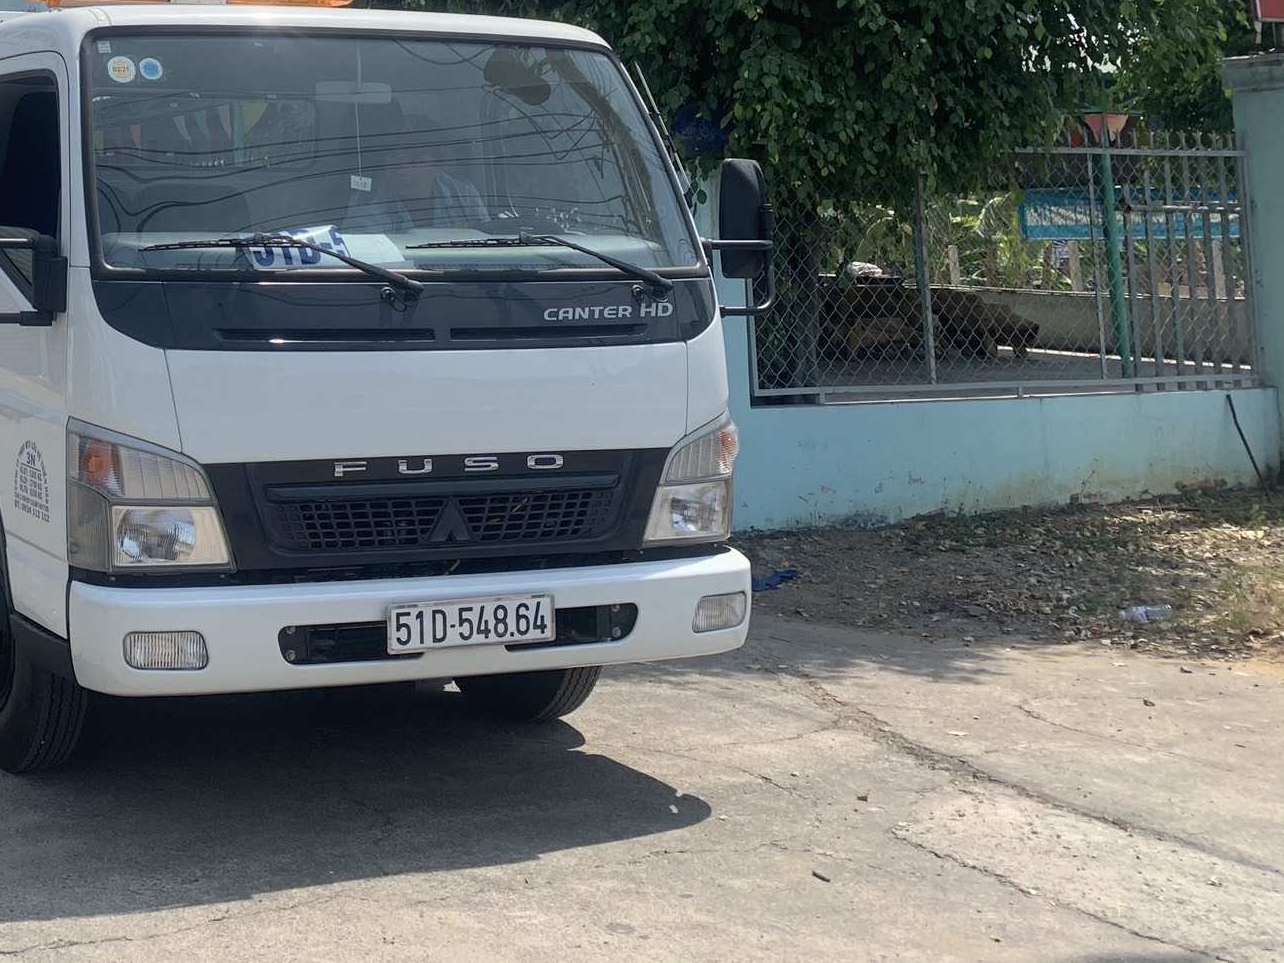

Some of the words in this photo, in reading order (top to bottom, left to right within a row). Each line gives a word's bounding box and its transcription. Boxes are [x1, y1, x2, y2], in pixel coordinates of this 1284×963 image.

[543, 305, 633, 321] CANTER
[640, 302, 673, 317] HD
[334, 454, 564, 477] FUSO
[395, 601, 547, 646] 51D-548.64
